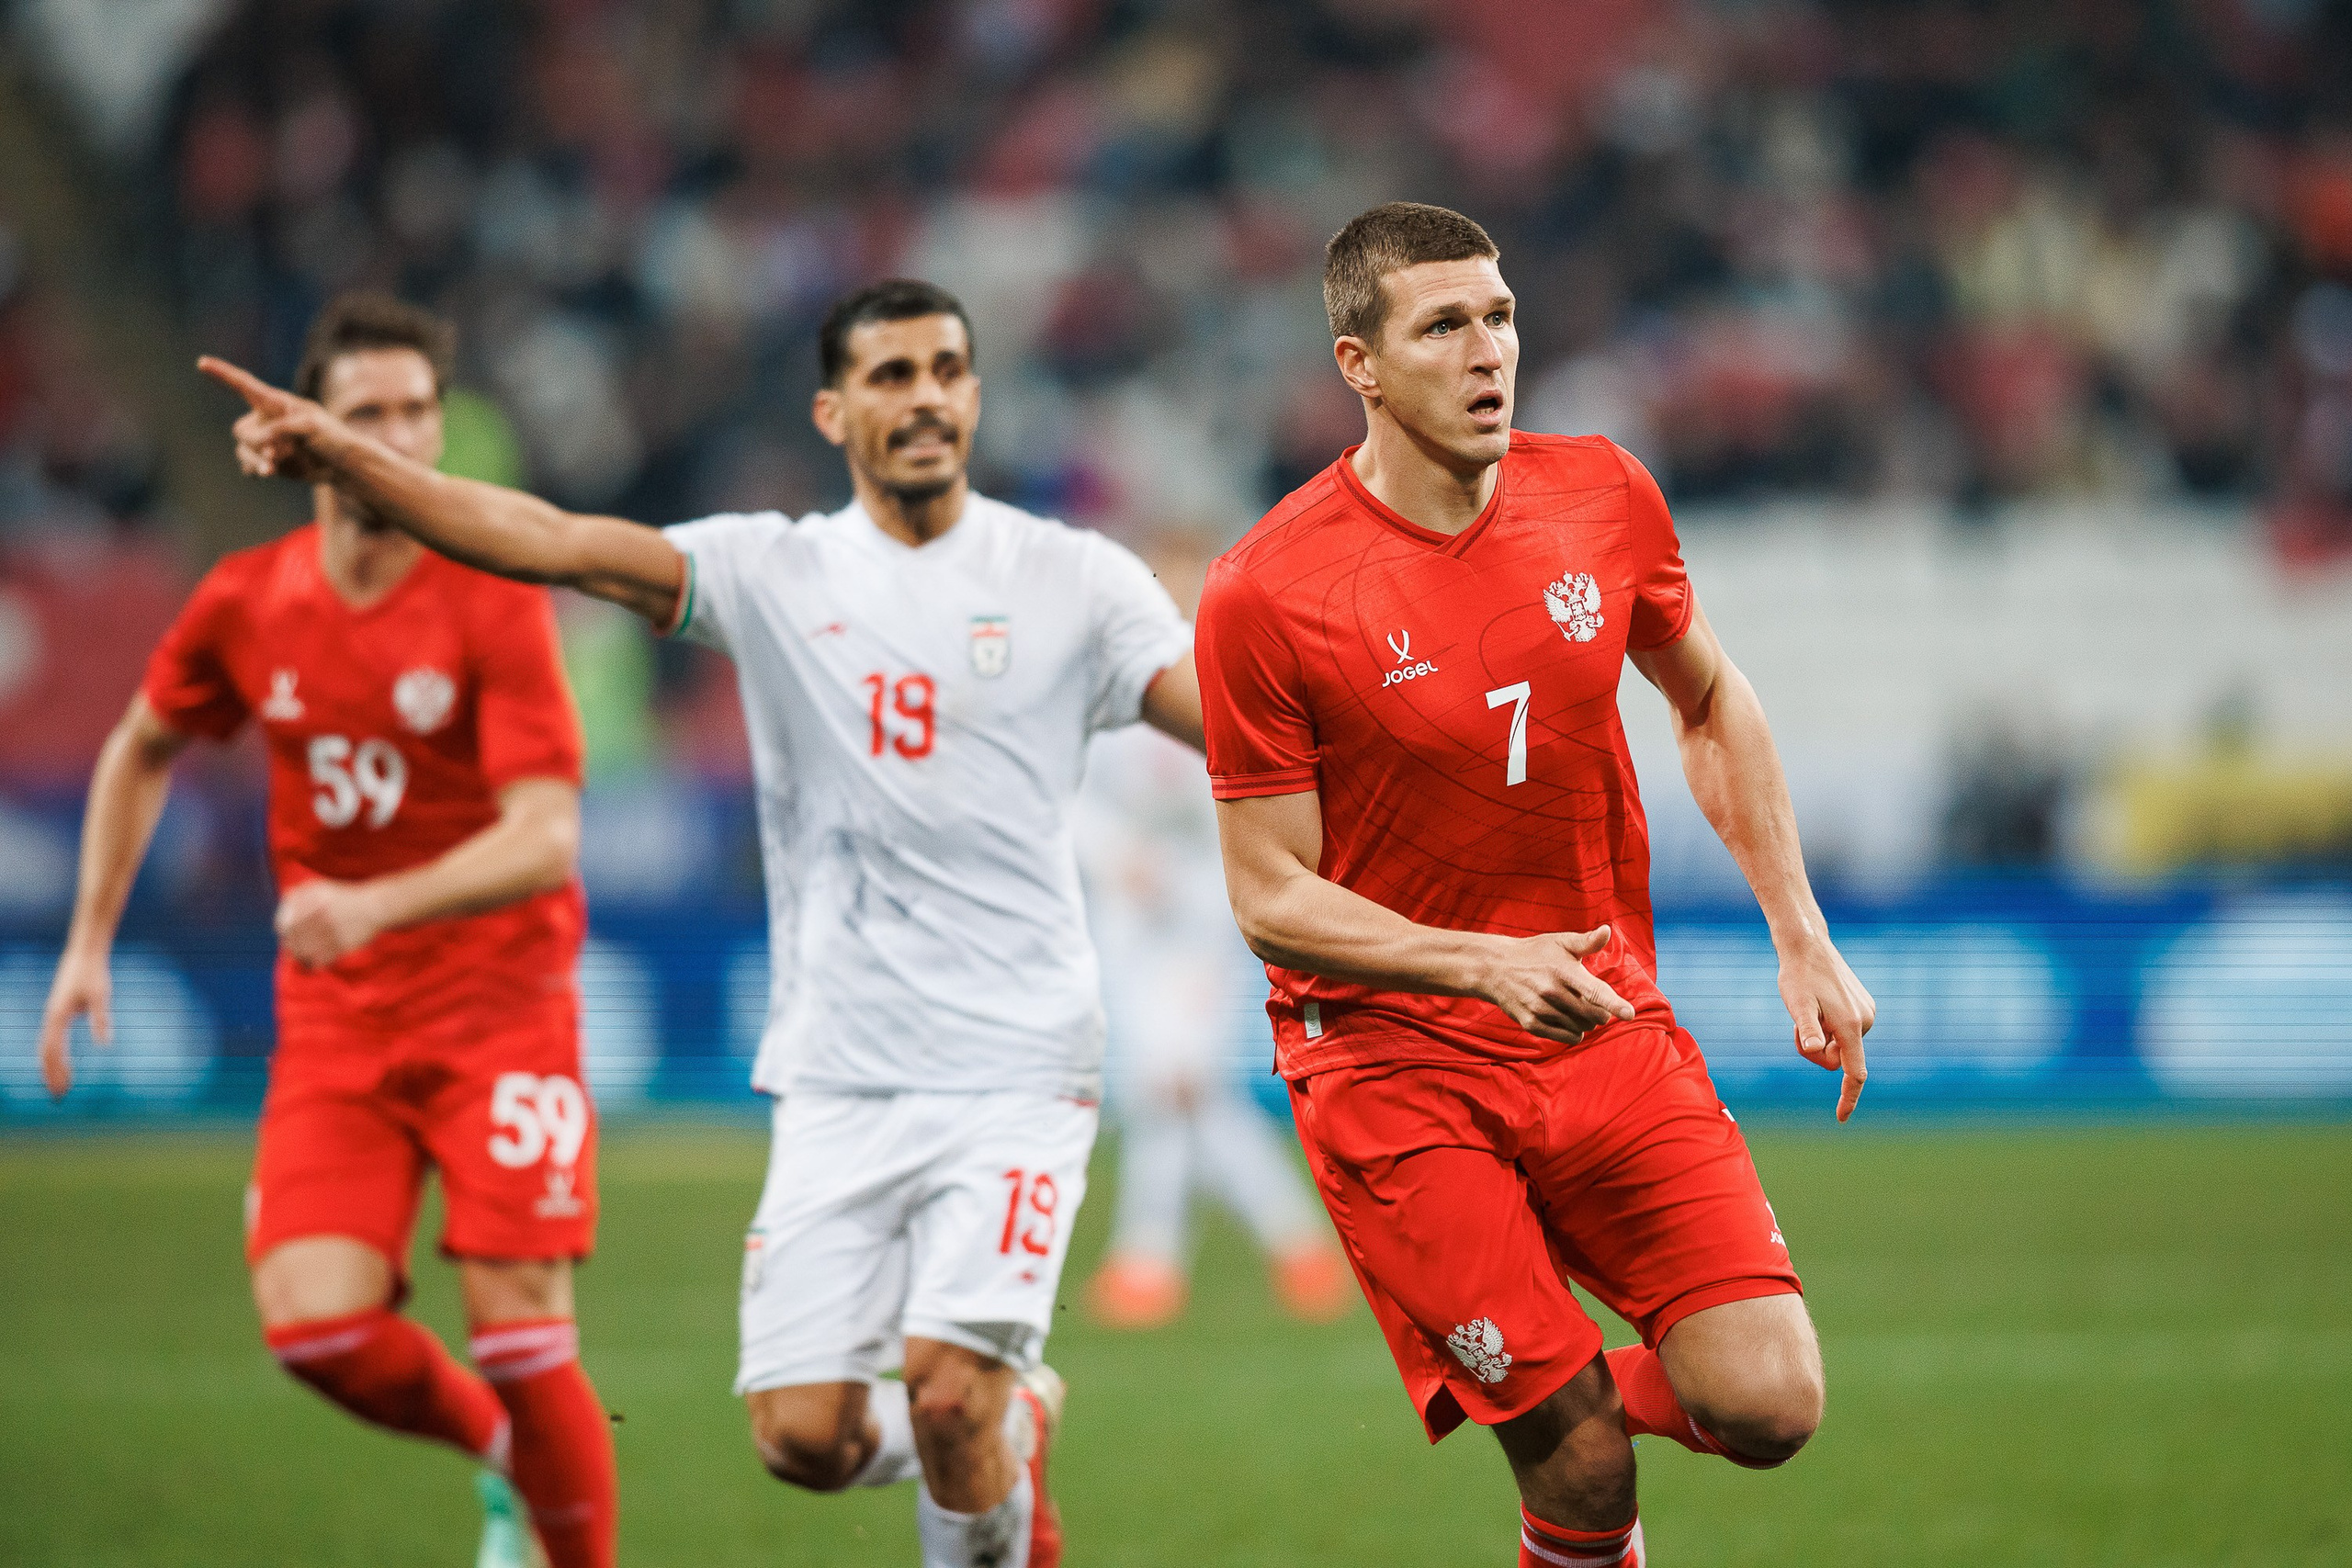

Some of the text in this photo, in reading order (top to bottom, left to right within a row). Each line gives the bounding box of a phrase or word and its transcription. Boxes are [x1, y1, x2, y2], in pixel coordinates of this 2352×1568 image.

[861, 670, 935, 761] 19
[1485, 681, 1532, 786] 7
[307, 735, 409, 829] 59
[488, 1071, 588, 1168] 59
[1000, 1168, 1057, 1257] 19
